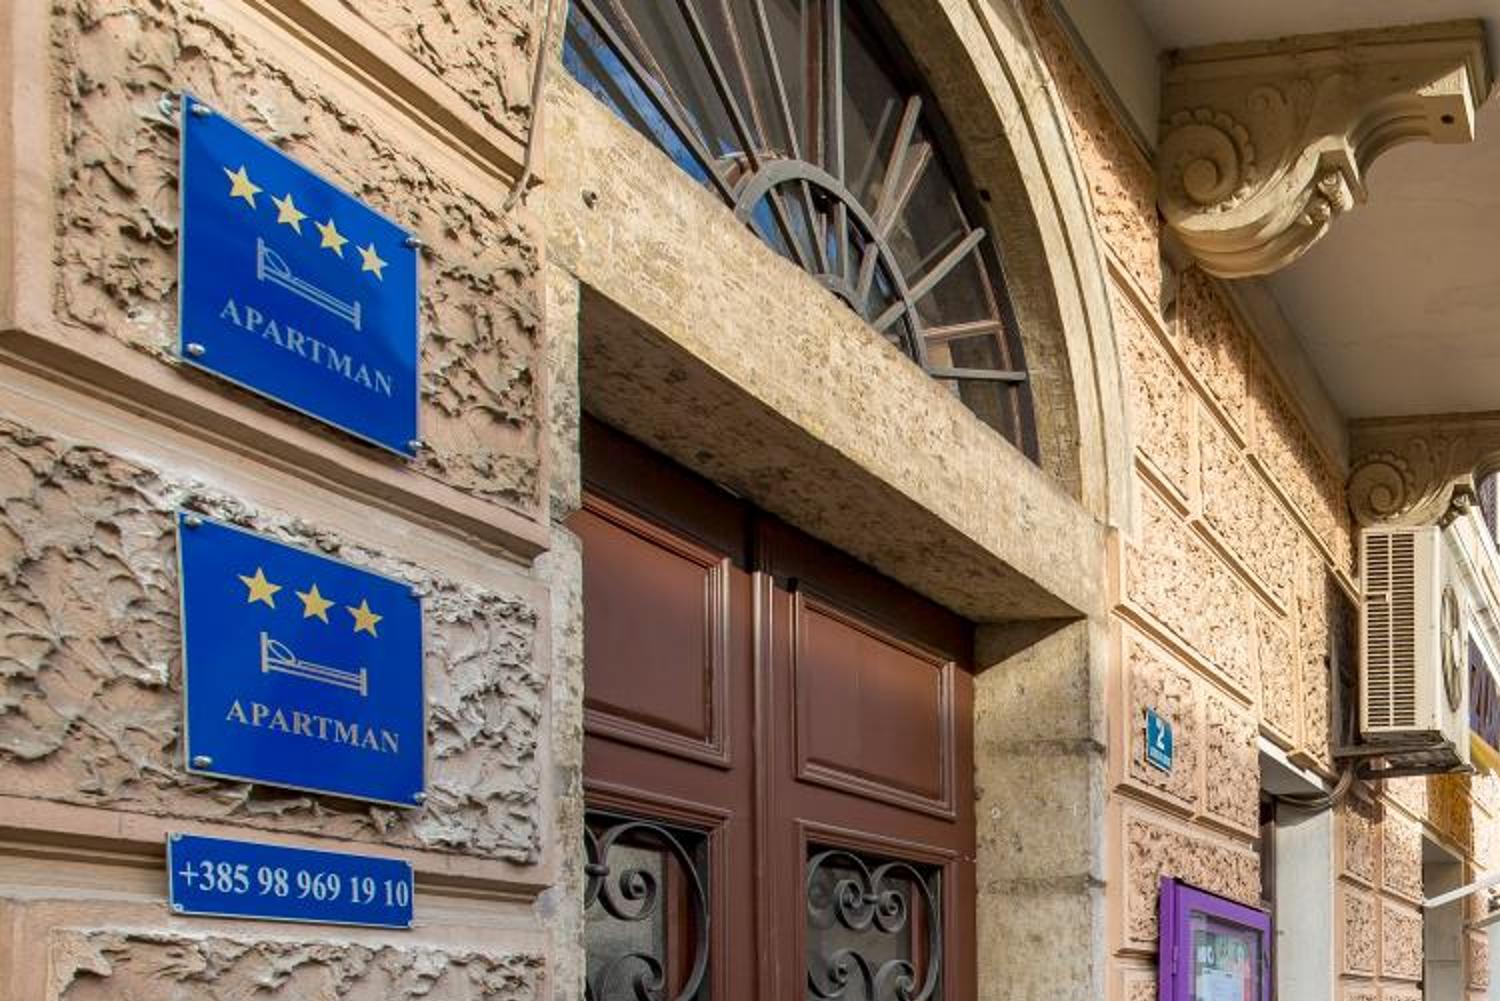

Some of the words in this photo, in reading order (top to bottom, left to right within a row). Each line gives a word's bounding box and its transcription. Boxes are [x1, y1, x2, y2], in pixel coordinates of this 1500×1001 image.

[219, 297, 393, 398] APARTMAN
[225, 699, 400, 753] APARTMAN
[179, 860, 250, 895] +385
[257, 865, 290, 898] 98
[296, 870, 341, 902] 969
[350, 876, 376, 905] 19
[384, 879, 409, 908] 10
